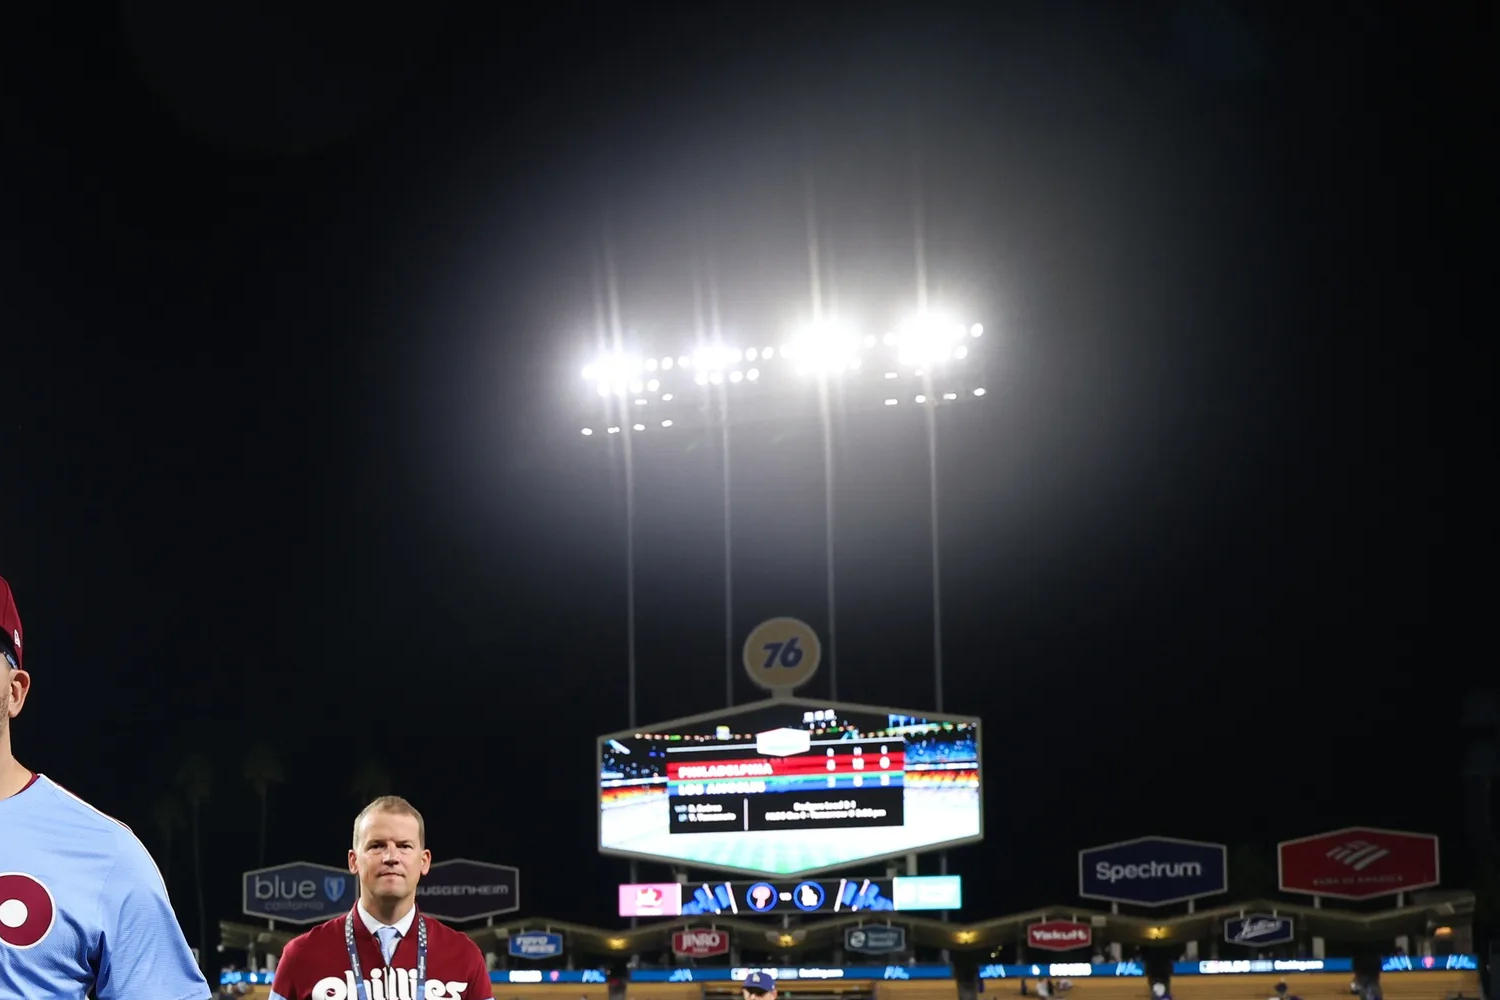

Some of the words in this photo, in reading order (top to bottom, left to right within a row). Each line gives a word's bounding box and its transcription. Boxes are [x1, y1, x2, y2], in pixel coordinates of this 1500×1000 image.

[763, 638, 803, 668] 76
[1096, 861, 1202, 884] Spectrum
[255, 876, 316, 899] blue
[682, 933, 720, 950] JINRO
